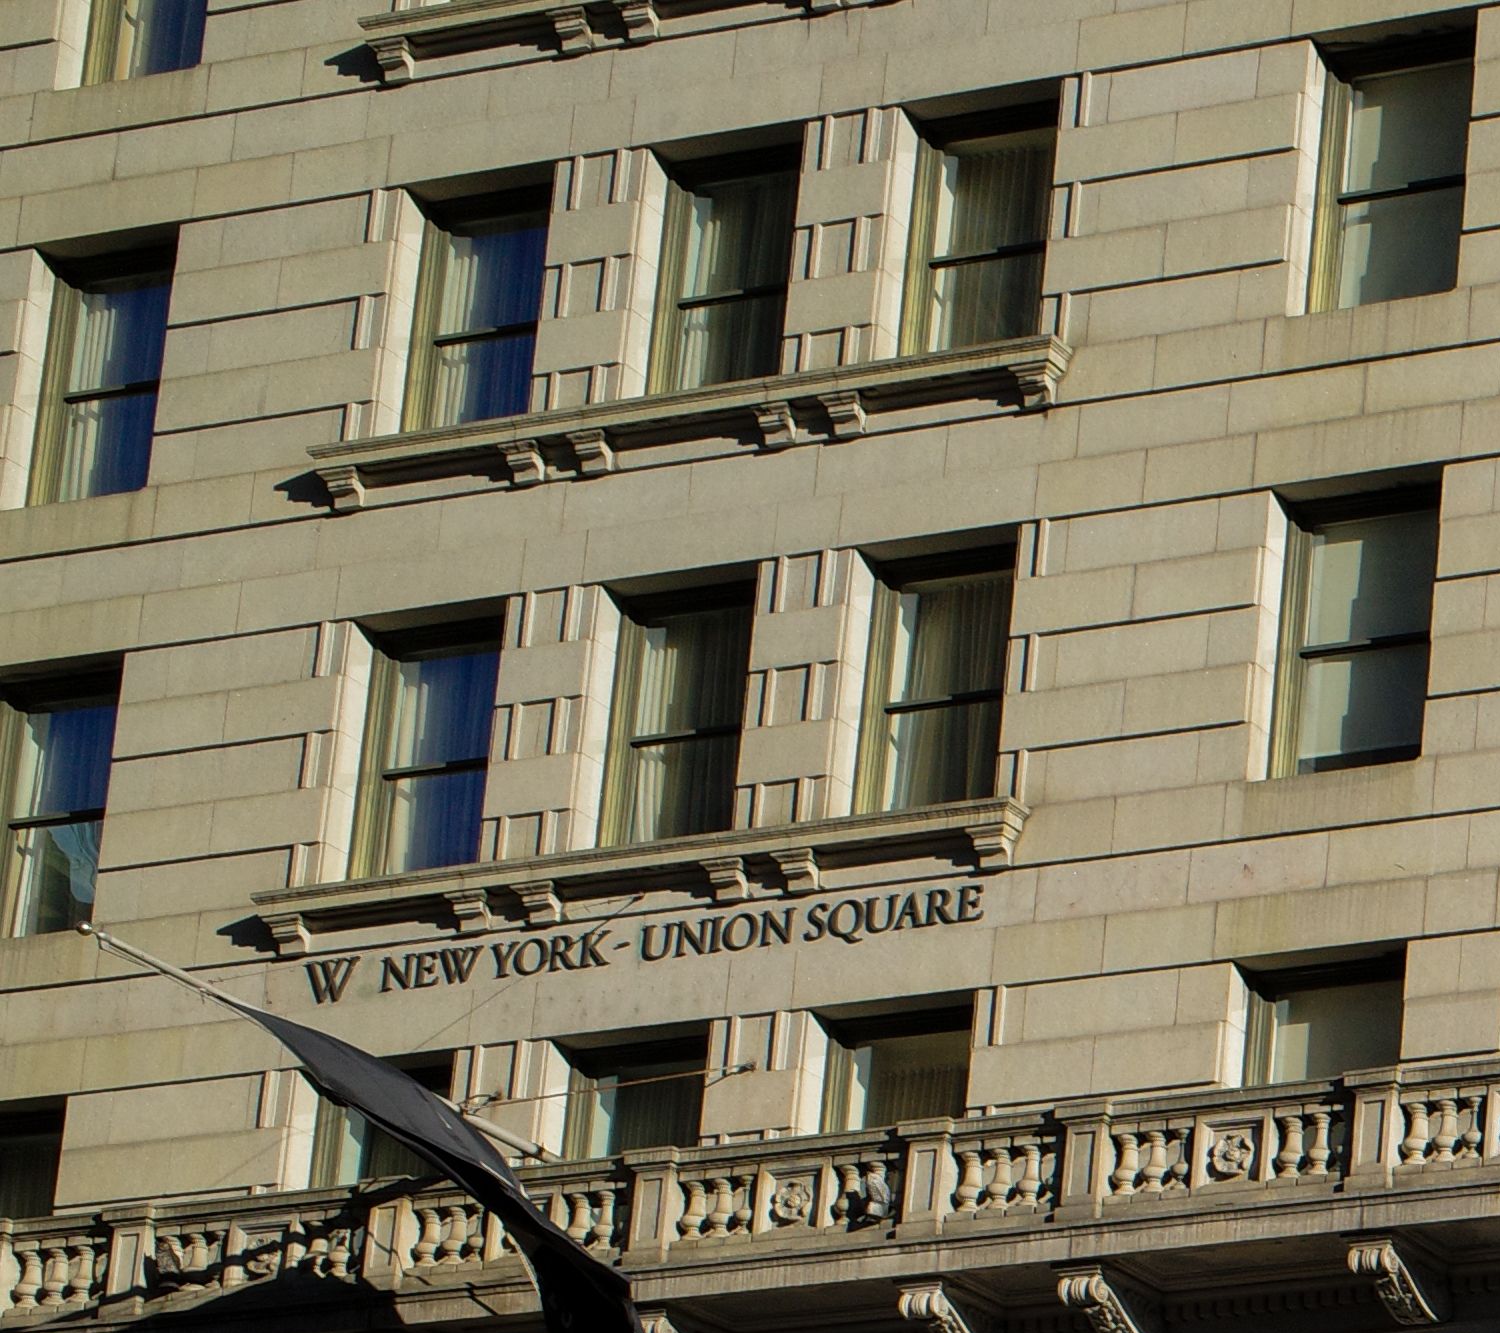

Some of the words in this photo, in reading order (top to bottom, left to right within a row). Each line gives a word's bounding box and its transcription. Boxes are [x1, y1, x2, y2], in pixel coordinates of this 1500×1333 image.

[305, 956, 361, 1004] W
[379, 944, 483, 994] NEW
[491, 929, 610, 980] YORK
[641, 907, 797, 962] UNION
[803, 884, 986, 945] SQUARE
